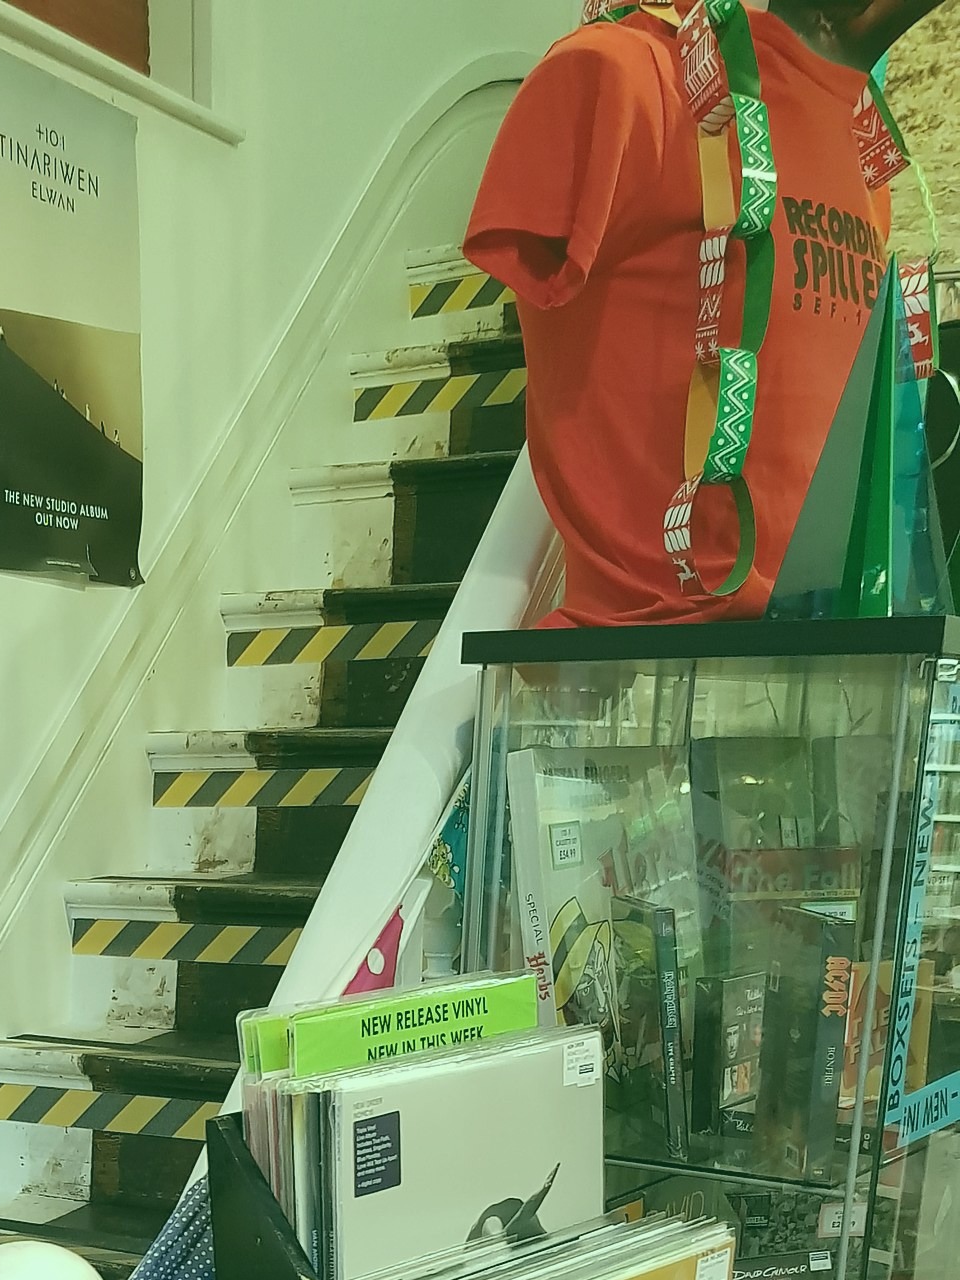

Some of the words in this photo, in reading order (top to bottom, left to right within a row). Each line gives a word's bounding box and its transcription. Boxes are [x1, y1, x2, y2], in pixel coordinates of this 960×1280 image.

[31, 180, 75, 213] ELWAN
[4, 489, 20, 505] THE
[23, 493, 44, 509] NEW
[46, 497, 77, 515] STUDIO
[79, 503, 109, 520] ALBUM
[35, 512, 54, 526] OUT
[55, 515, 79, 530] NOW
[559, 848, 577, 861] £54.99
[525, 893, 544, 946] SPECIAL
[887, 937, 918, 1112] BOXSETS
[913, 796, 934, 887] NEW
[361, 1013, 392, 1038] NEW
[396, 1004, 449, 1032] RELEASE
[451, 996, 489, 1021] VINYL
[367, 1041, 399, 1062] NEW
[401, 1039, 417, 1058] IN
[419, 1031, 448, 1052] THIS
[450, 1025, 484, 1045] WEEK
[824, 1047, 836, 1087] BONFIRE
[922, 1087, 949, 1128] NEW
